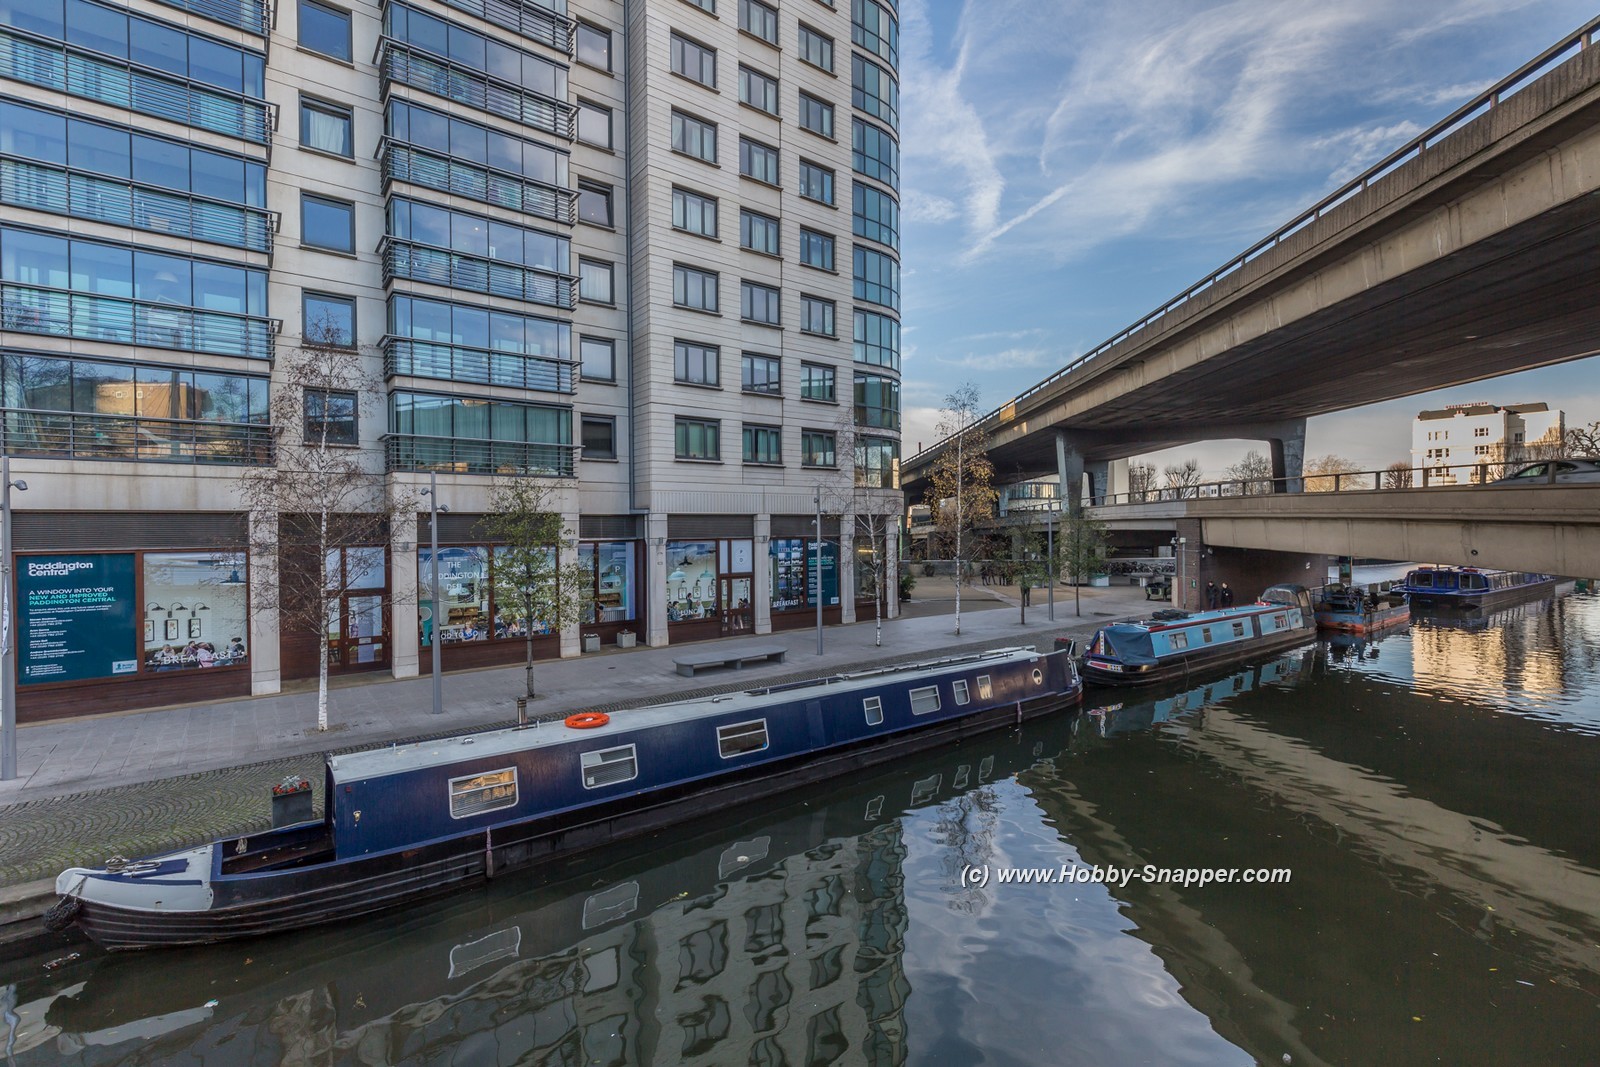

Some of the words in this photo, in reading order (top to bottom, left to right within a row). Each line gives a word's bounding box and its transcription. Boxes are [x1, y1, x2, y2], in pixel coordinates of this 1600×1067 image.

[28, 562, 93, 570] Paddington
[447, 561, 461, 569] THE
[428, 572, 480, 580] PDDINGTON
